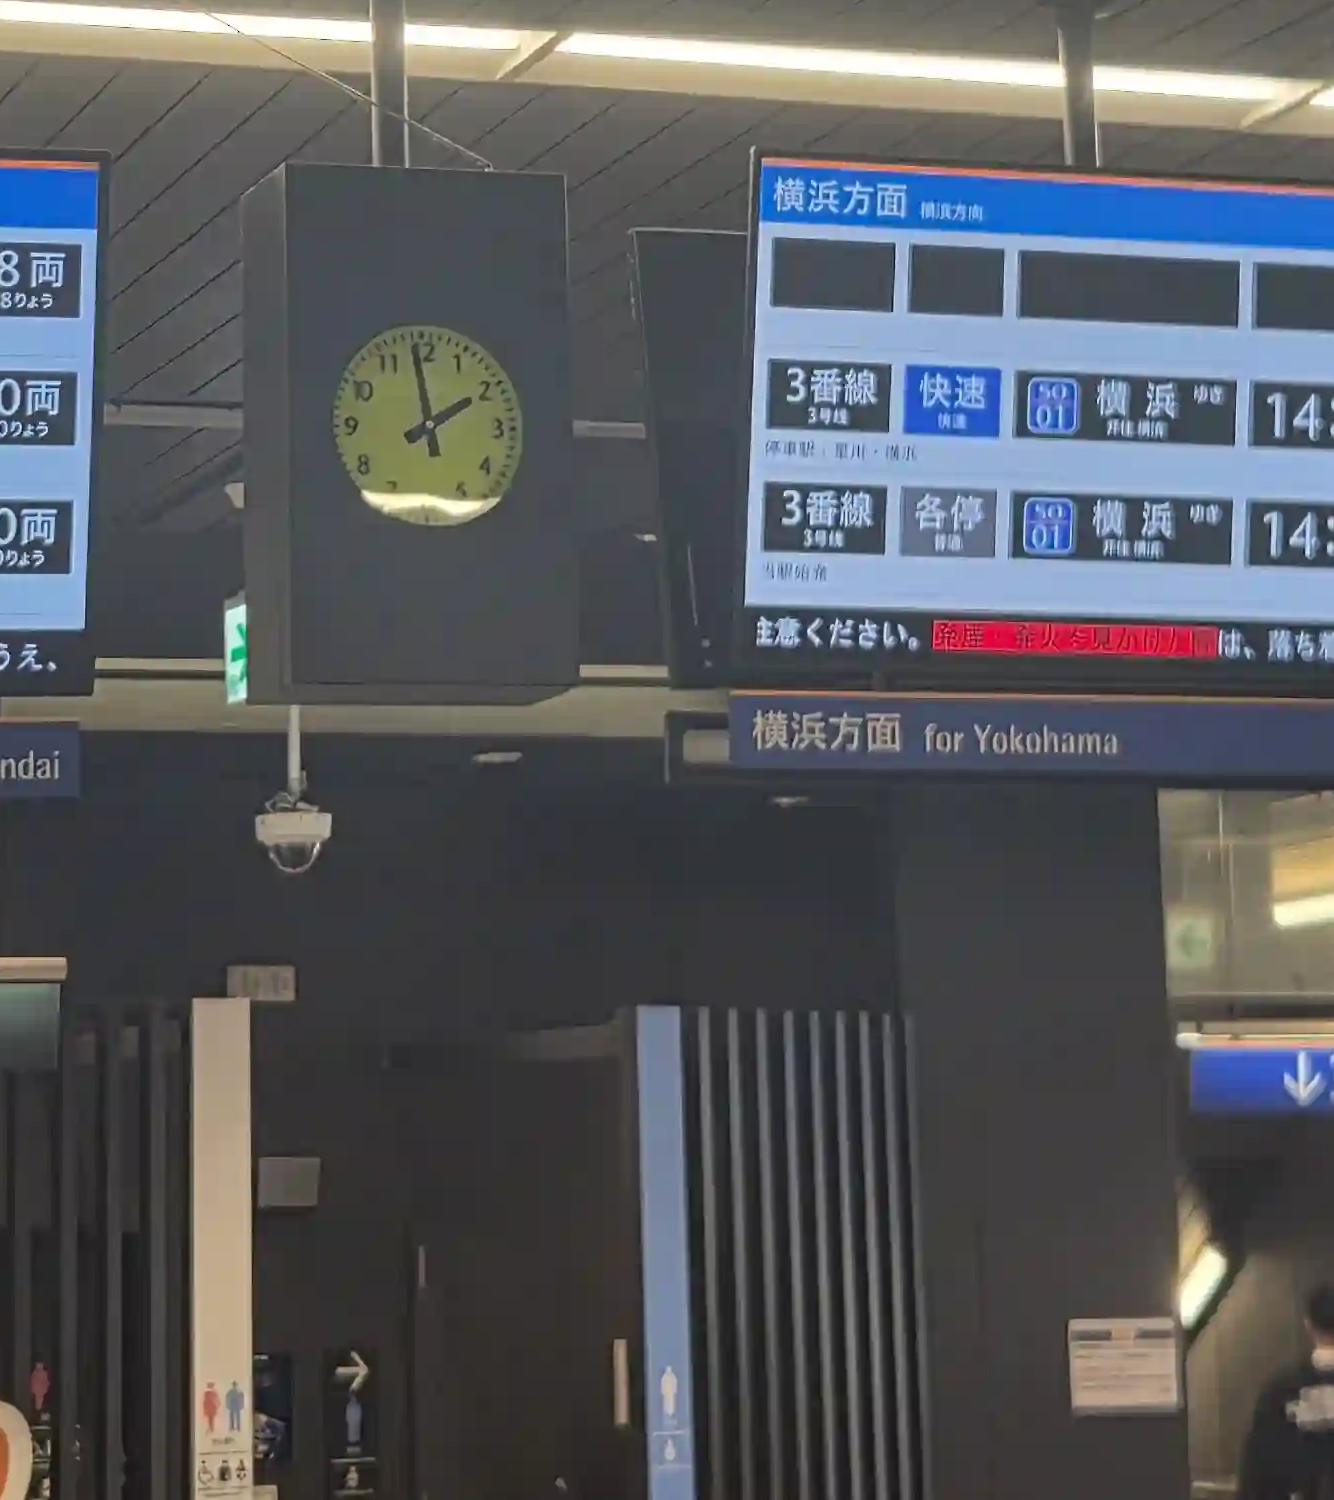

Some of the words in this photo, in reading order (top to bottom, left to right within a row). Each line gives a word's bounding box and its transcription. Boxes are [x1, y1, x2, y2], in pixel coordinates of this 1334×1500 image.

[773, 176, 908, 219] 横浜方面
[0, 290, 54, 311] 8りょう
[379, 353, 398, 374] 11
[453, 354, 461, 374] 1
[354, 380, 373, 402] 10
[478, 380, 493, 401] 2
[785, 367, 878, 407] 3番線
[920, 372, 986, 410] 快速
[1096, 378, 1179, 419] 横浜
[343, 415, 359, 437] 9
[492, 418, 505, 439] 3
[357, 454, 371, 476] 8
[478, 455, 492, 476] 4
[781, 489, 873, 529] 3番線
[915, 494, 986, 533] 各停
[1092, 499, 1175, 540] 横浜
[753, 711, 901, 753] 横浜方面
[924, 723, 965, 754] for
[974, 722, 1120, 756] Yokohama
